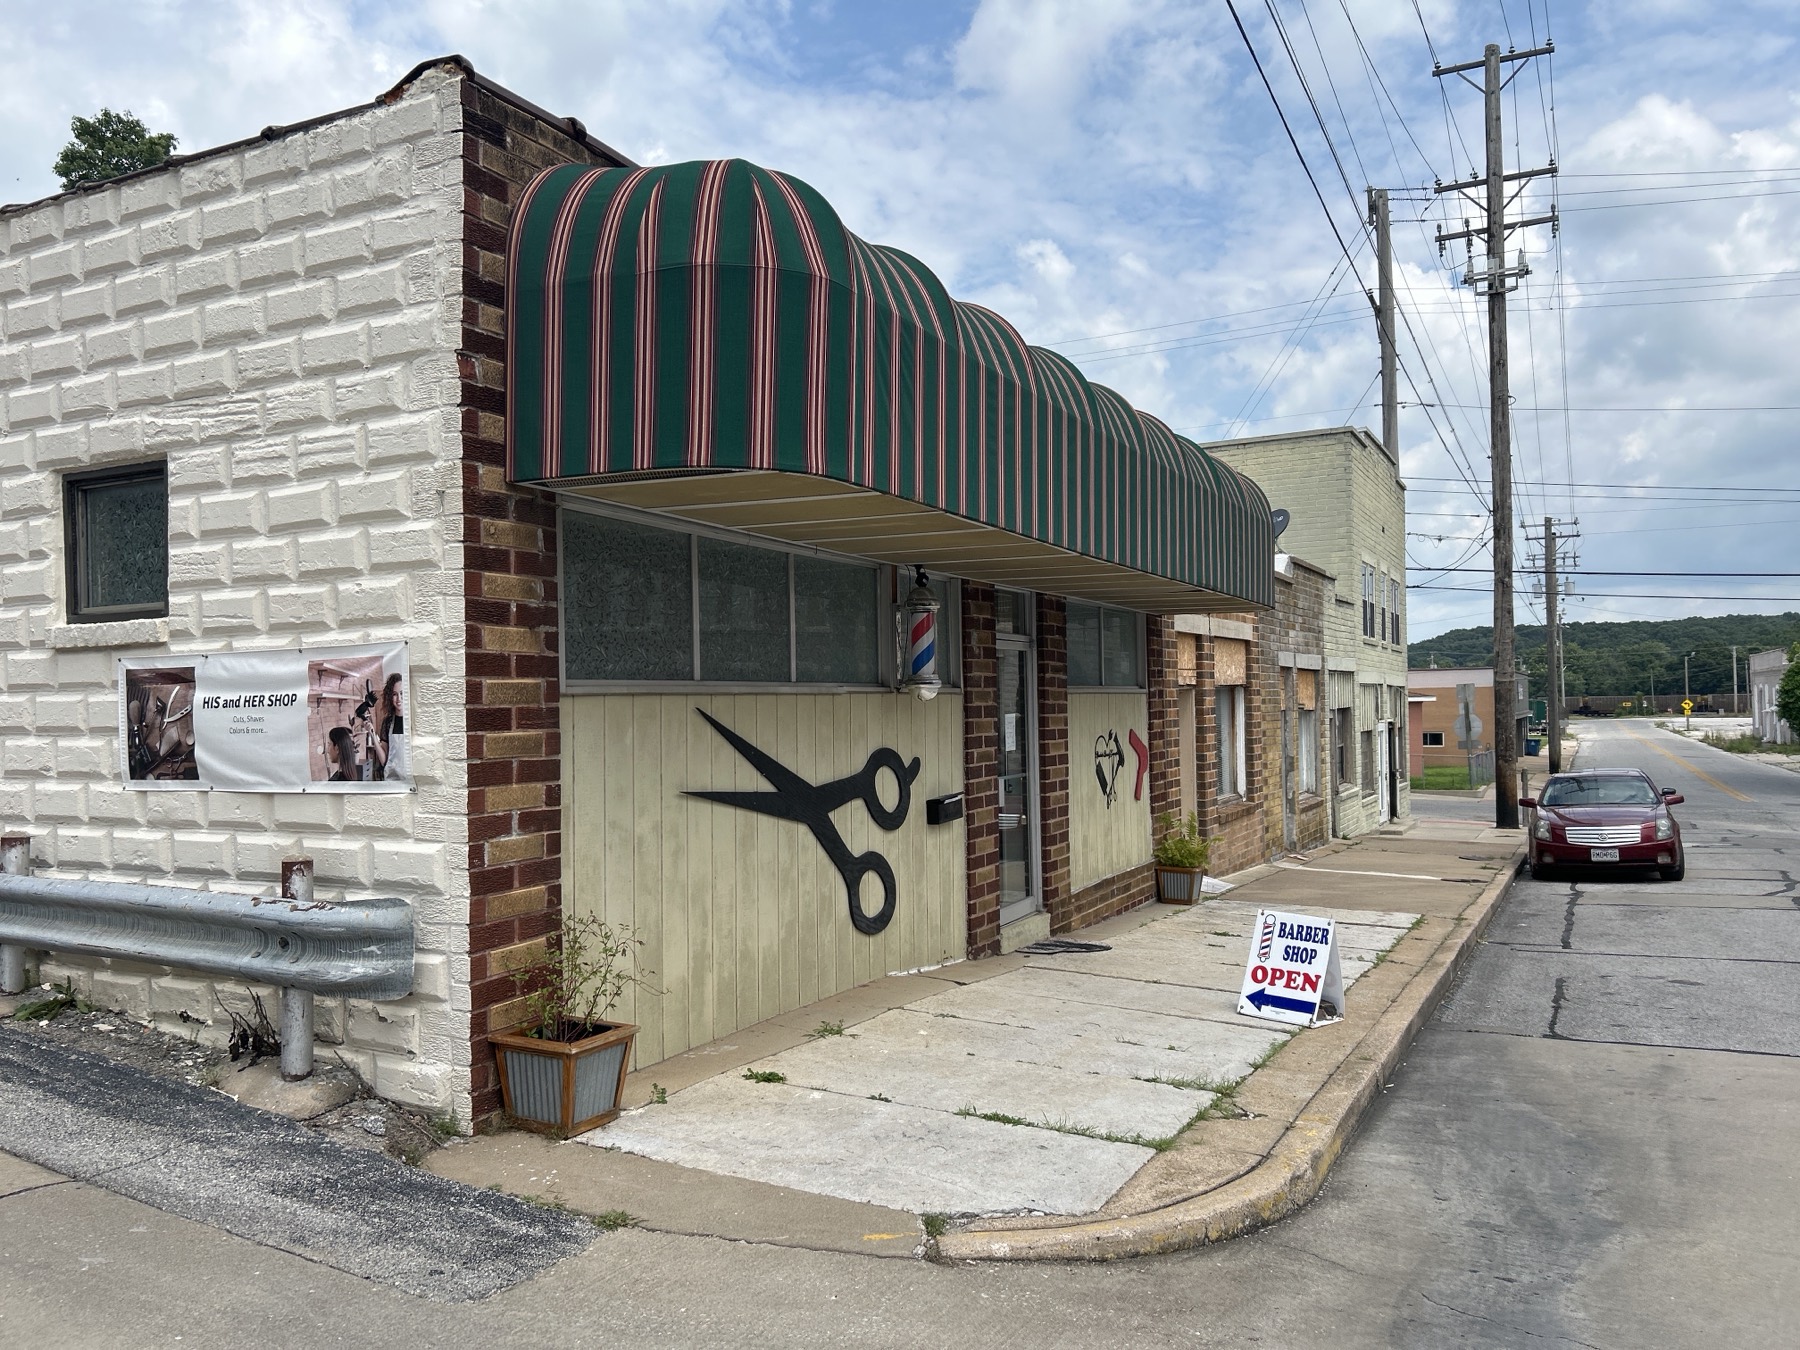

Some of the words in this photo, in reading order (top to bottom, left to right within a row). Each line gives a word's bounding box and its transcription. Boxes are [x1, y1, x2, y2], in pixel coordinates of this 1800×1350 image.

[202, 696, 221, 709] HIS
[222, 695, 241, 709] and
[243, 694, 265, 708] HER
[267, 693, 297, 707] SHOP
[233, 715, 246, 723] Cuts,
[246, 715, 265, 723] Shaves
[1278, 922, 1329, 945] BARBER
[1283, 945, 1317, 965] SHOP
[1251, 965, 1321, 993] OPEN
